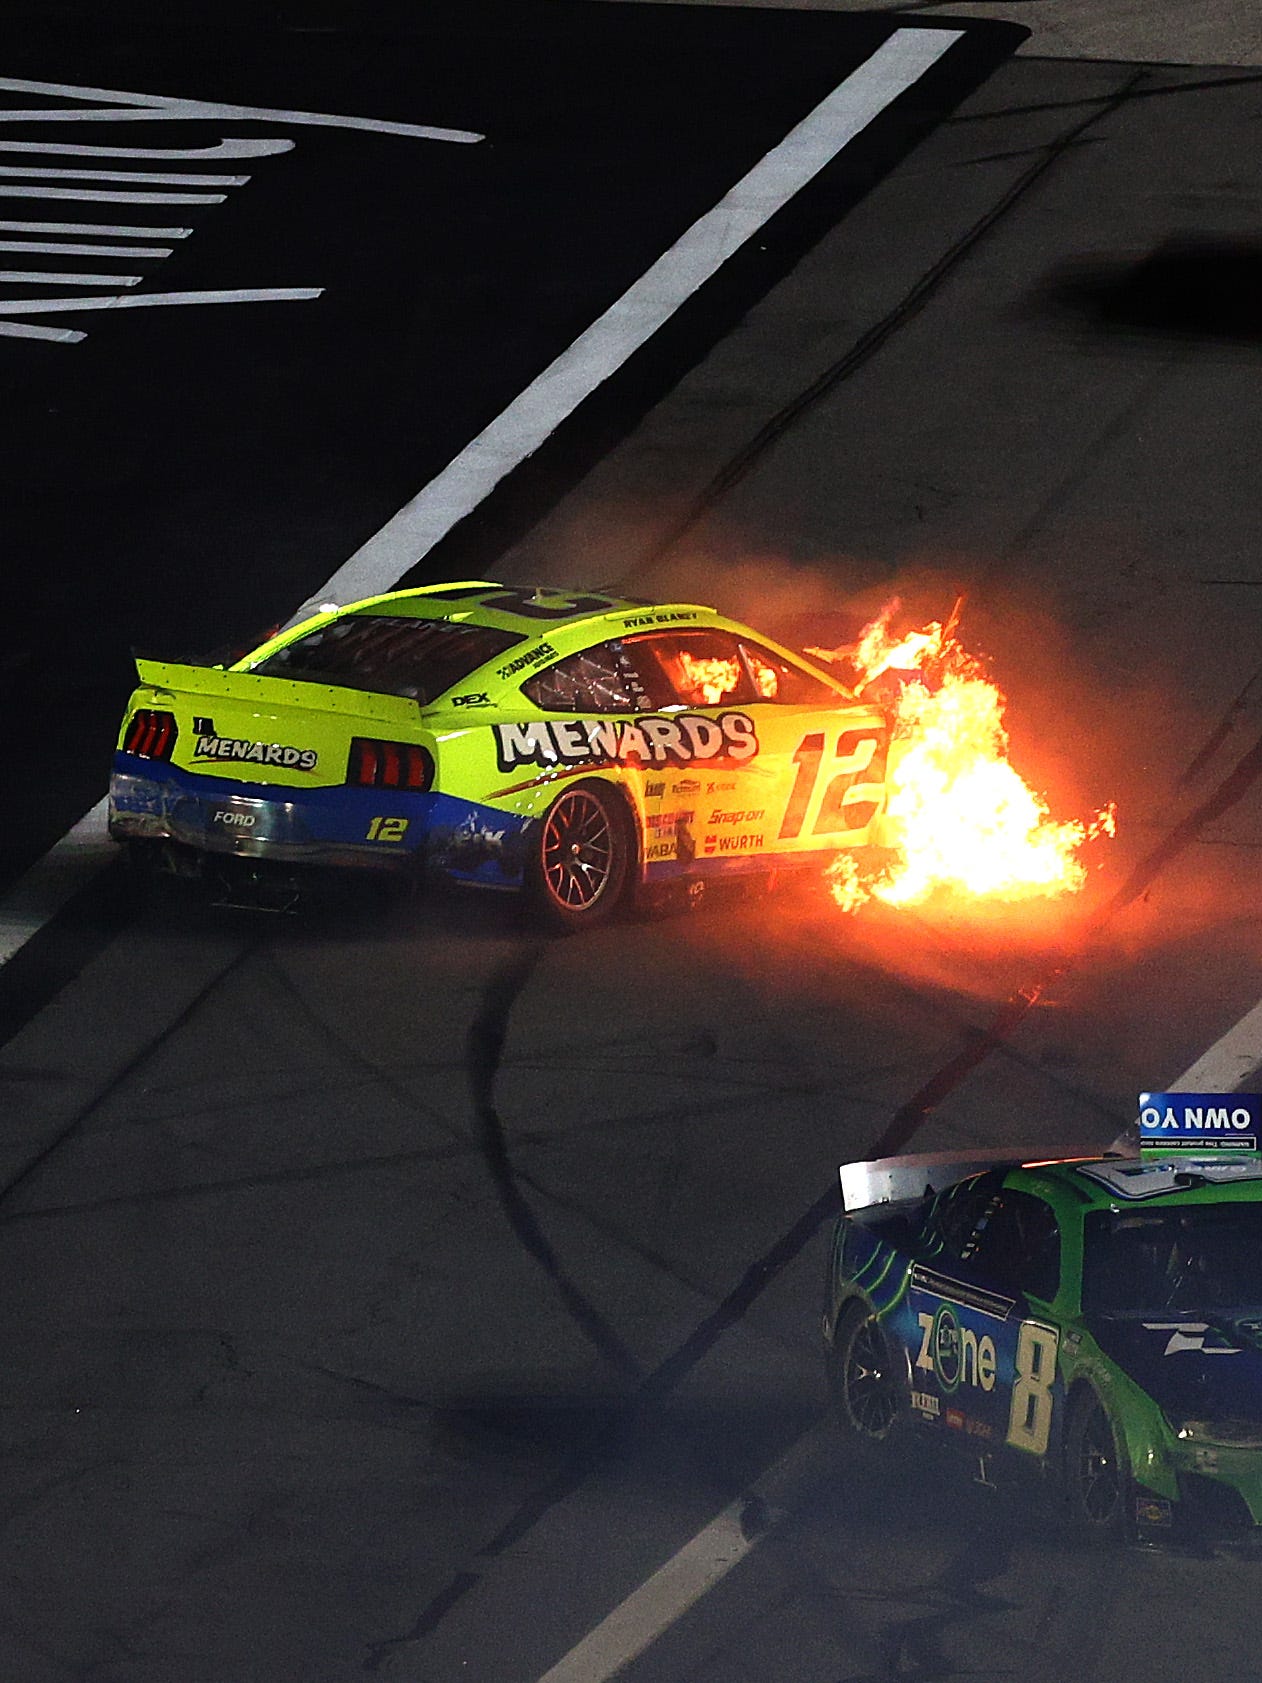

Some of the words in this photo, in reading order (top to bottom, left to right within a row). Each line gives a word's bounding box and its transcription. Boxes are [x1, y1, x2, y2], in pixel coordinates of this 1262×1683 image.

[623, 615, 655, 629] RYAN
[508, 642, 556, 675] ADVANCE
[451, 692, 489, 707] DEX
[495, 713, 760, 768] MENARDS
[195, 735, 319, 770] MENARDS
[777, 727, 888, 840] 12
[213, 810, 256, 827] FORD
[708, 809, 765, 825] Snap-on
[365, 816, 409, 842] 12
[719, 834, 764, 851] WÜRTH
[1140, 1107, 1180, 1129] YO
[1185, 1107, 1251, 1130] OWN
[1006, 1320, 1060, 1454] 8
